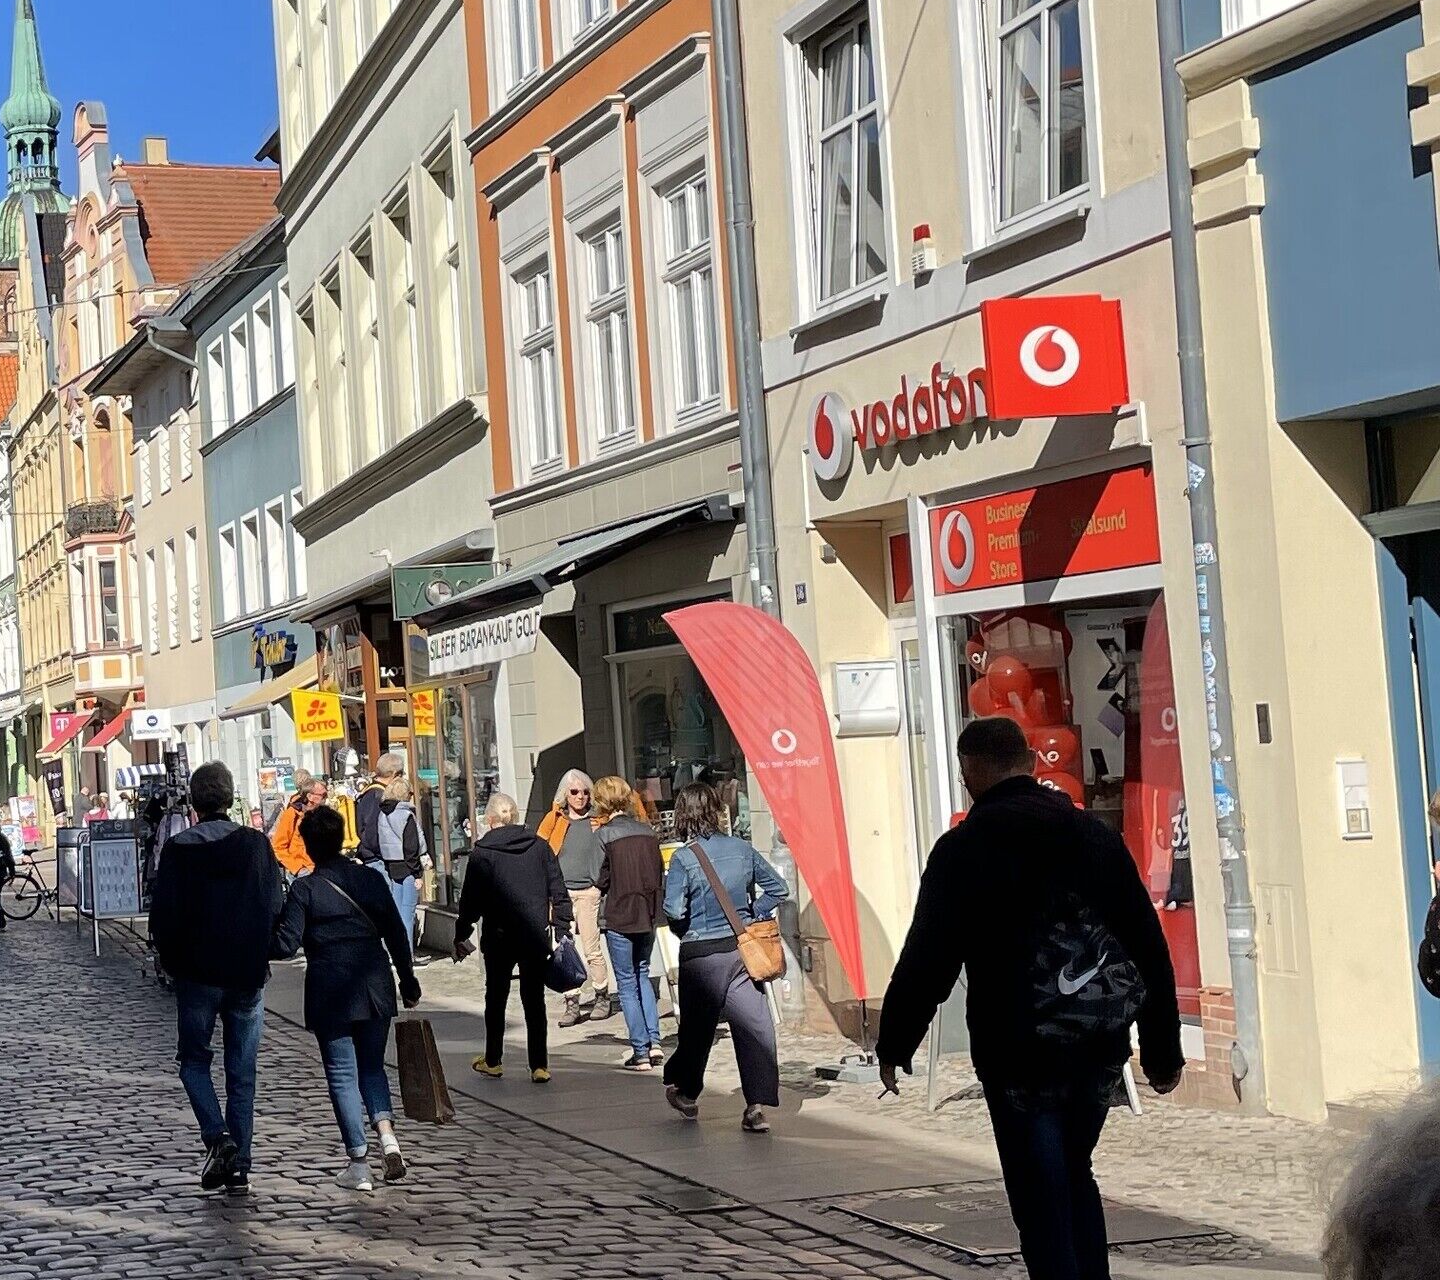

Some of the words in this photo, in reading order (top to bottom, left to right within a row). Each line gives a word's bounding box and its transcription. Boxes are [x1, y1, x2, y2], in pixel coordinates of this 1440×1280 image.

[850, 361, 988, 451] vodafon
[985, 501, 1031, 525] Business
[989, 560, 1017, 580] Store
[460, 619, 513, 653] BARANKAUF
[300, 719, 338, 733] LOTTO
